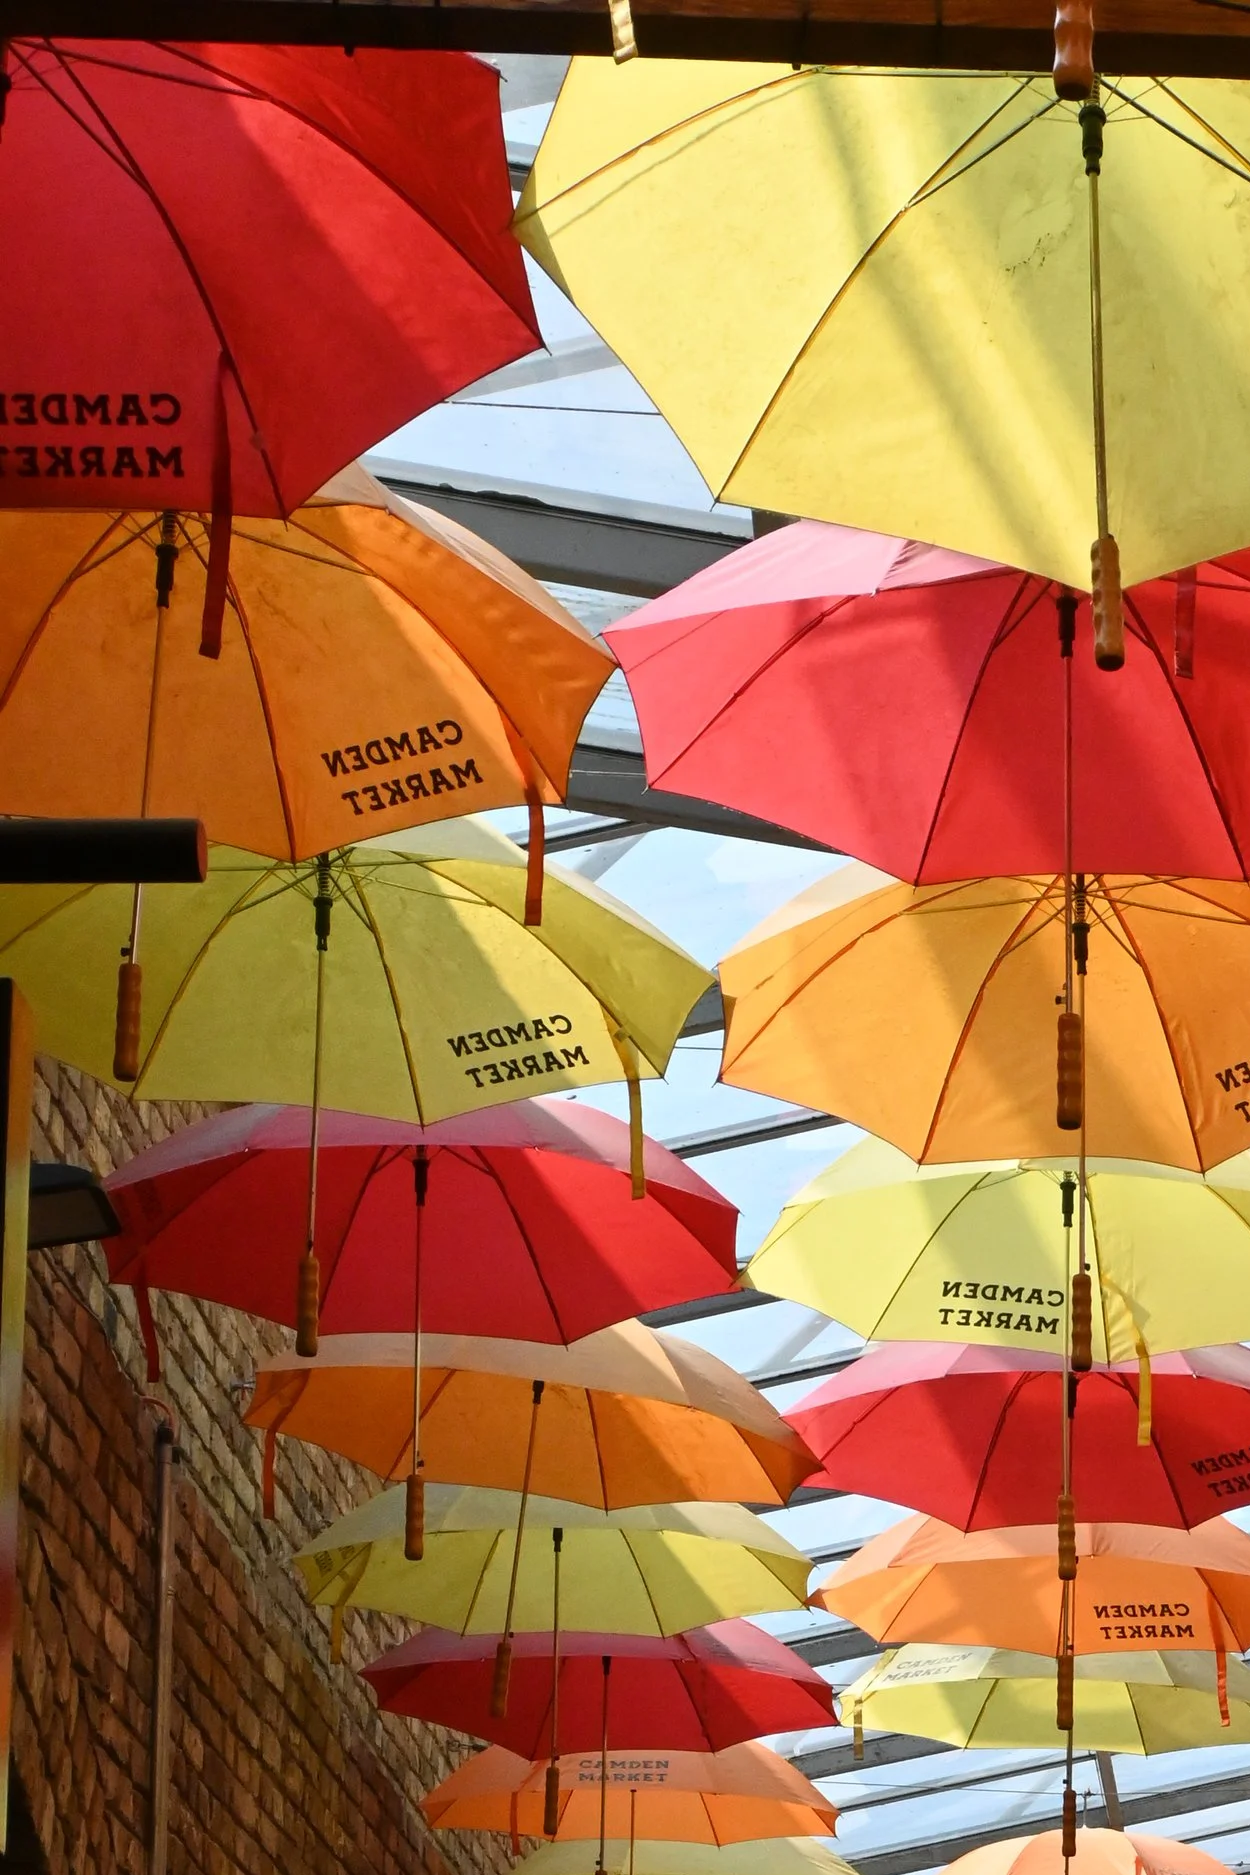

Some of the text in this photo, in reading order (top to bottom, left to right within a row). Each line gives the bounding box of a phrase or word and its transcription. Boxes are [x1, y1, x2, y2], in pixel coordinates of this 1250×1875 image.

[896, 1652, 973, 1670] CAMDEN
[882, 1664, 958, 1682] MARKET
[579, 1760, 669, 1769] CAMDEN
[578, 1773, 668, 1782] MARKET
